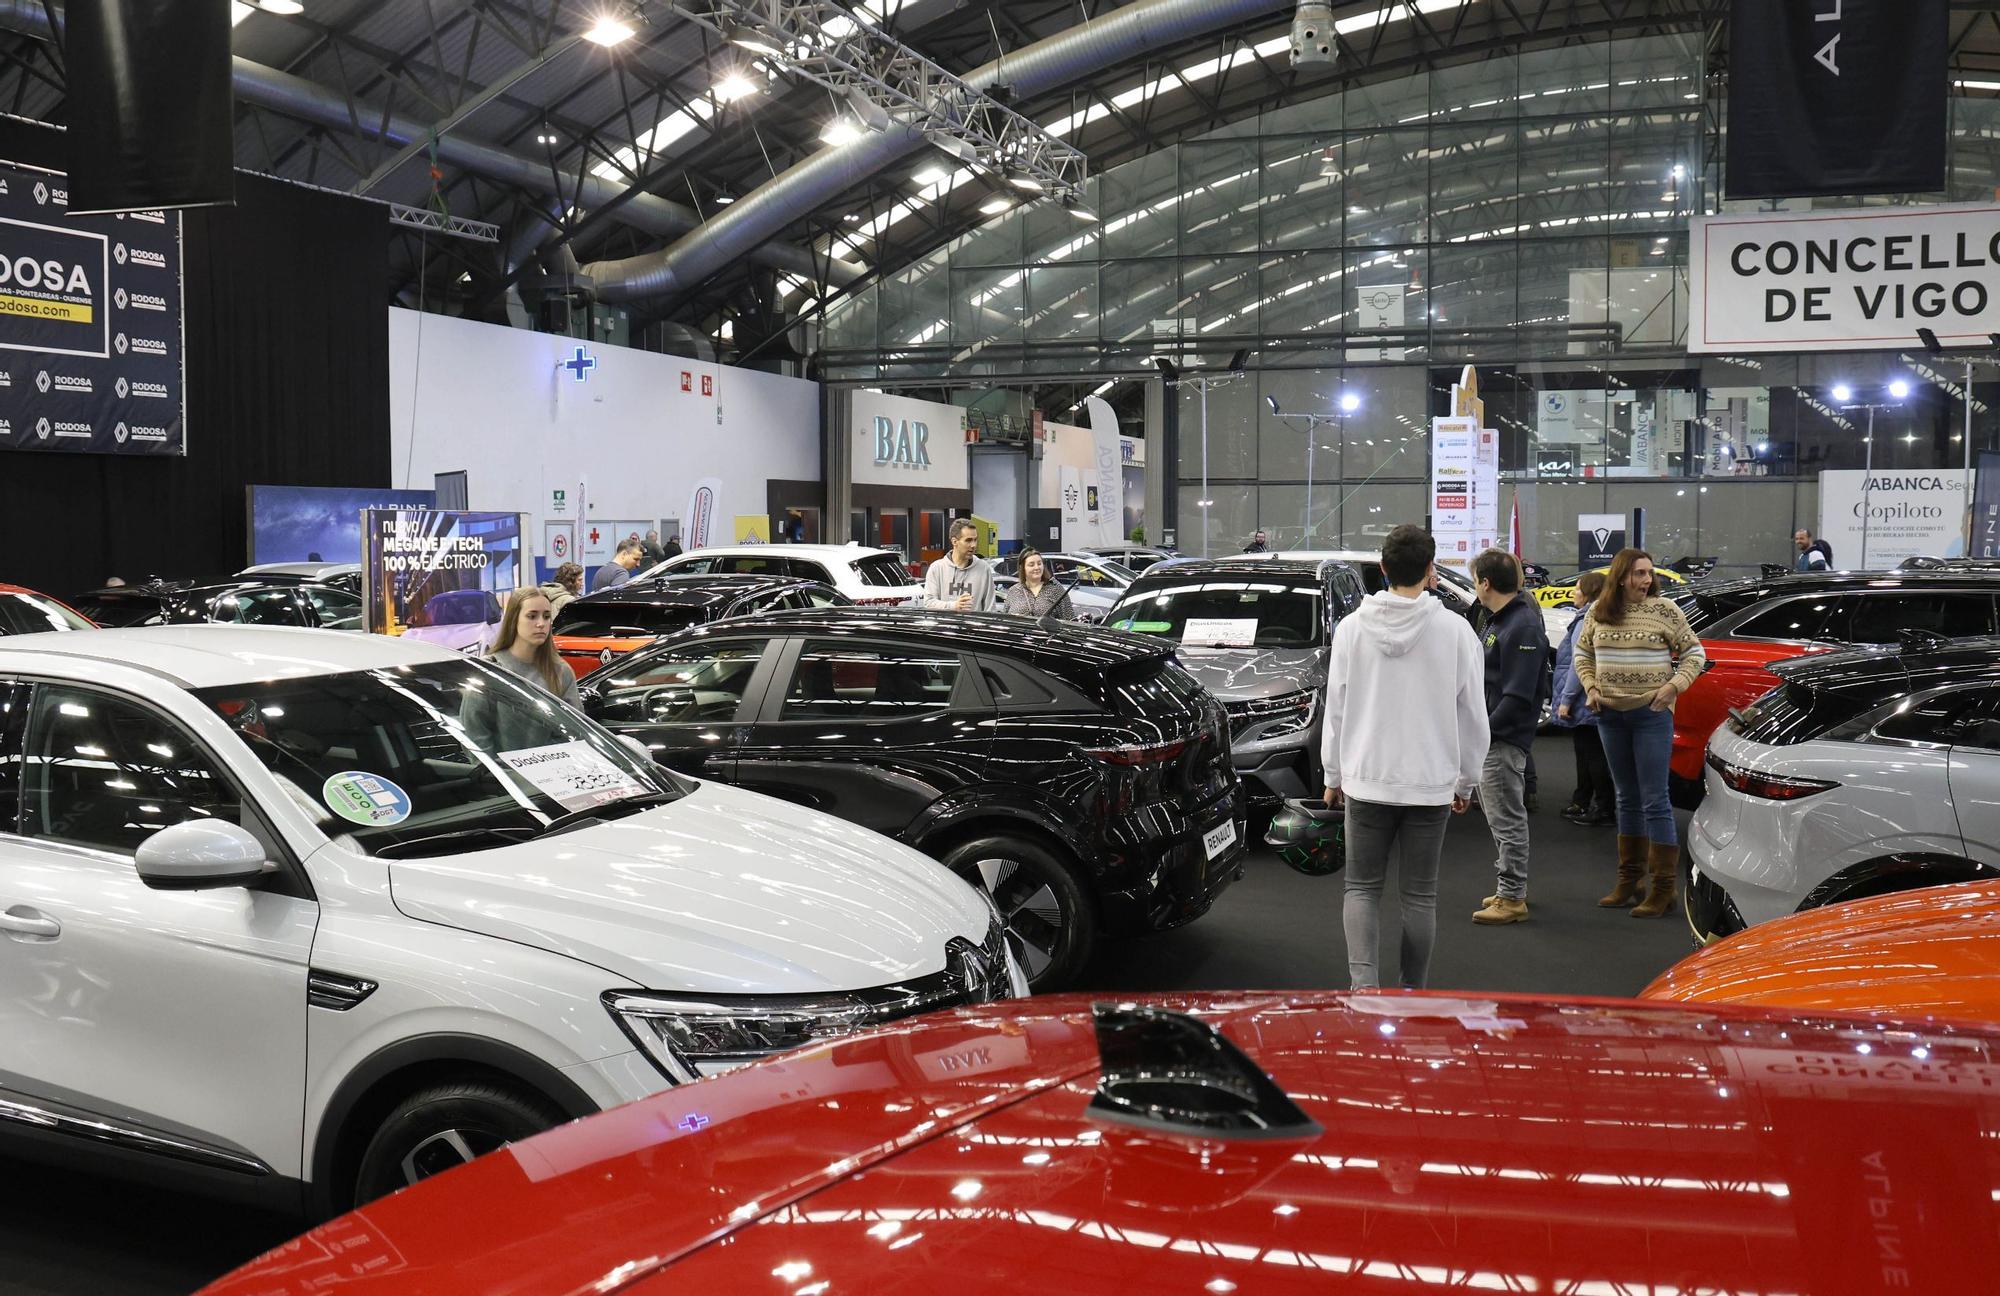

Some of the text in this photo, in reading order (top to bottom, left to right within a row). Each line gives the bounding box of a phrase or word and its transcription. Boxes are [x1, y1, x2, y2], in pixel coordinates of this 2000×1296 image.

[131, 249, 165, 262] RODOSA
[131, 293, 166, 306] RODOSA
[1765, 280, 1988, 322] DE VIGO
[131, 338, 167, 350] RODOSA
[54, 376, 92, 387] RODOSA
[131, 382, 167, 393] RODOSA
[54, 422, 92, 432] RODOSA
[131, 426, 167, 436] RODOSA
[872, 415, 931, 466] BAR
[1853, 502, 1943, 523] Copiloto
[384, 555, 407, 572] 100
[379, 808, 394, 816] DGT
[1207, 822, 1233, 852] RENAULT
